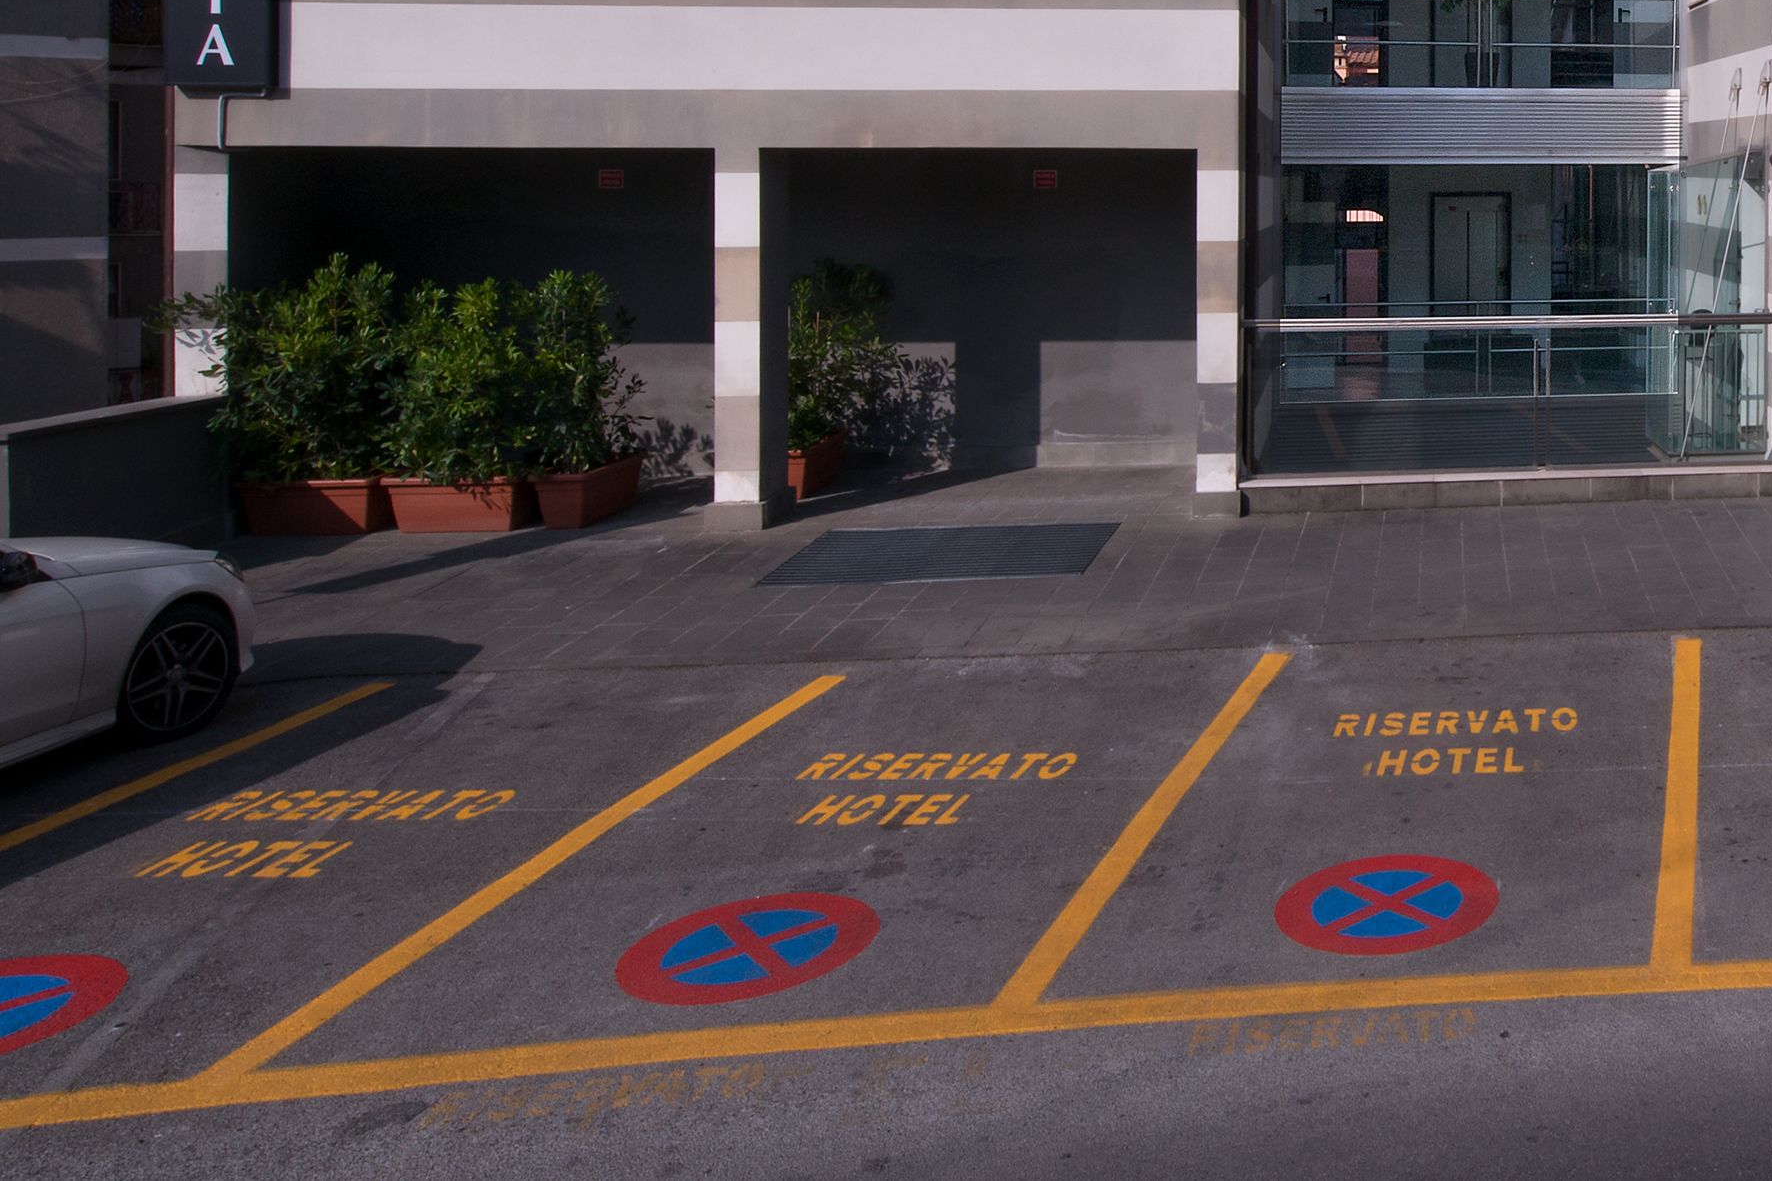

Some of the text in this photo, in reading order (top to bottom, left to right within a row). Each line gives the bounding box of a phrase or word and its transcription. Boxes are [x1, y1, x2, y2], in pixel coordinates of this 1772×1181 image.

[1333, 707, 1579, 737] RISERVATO
[795, 751, 1078, 781] RISERVATO
[1375, 746, 1526, 776] HOTEL
[795, 793, 970, 826] HOTEL
[133, 840, 353, 879] HOTEL
